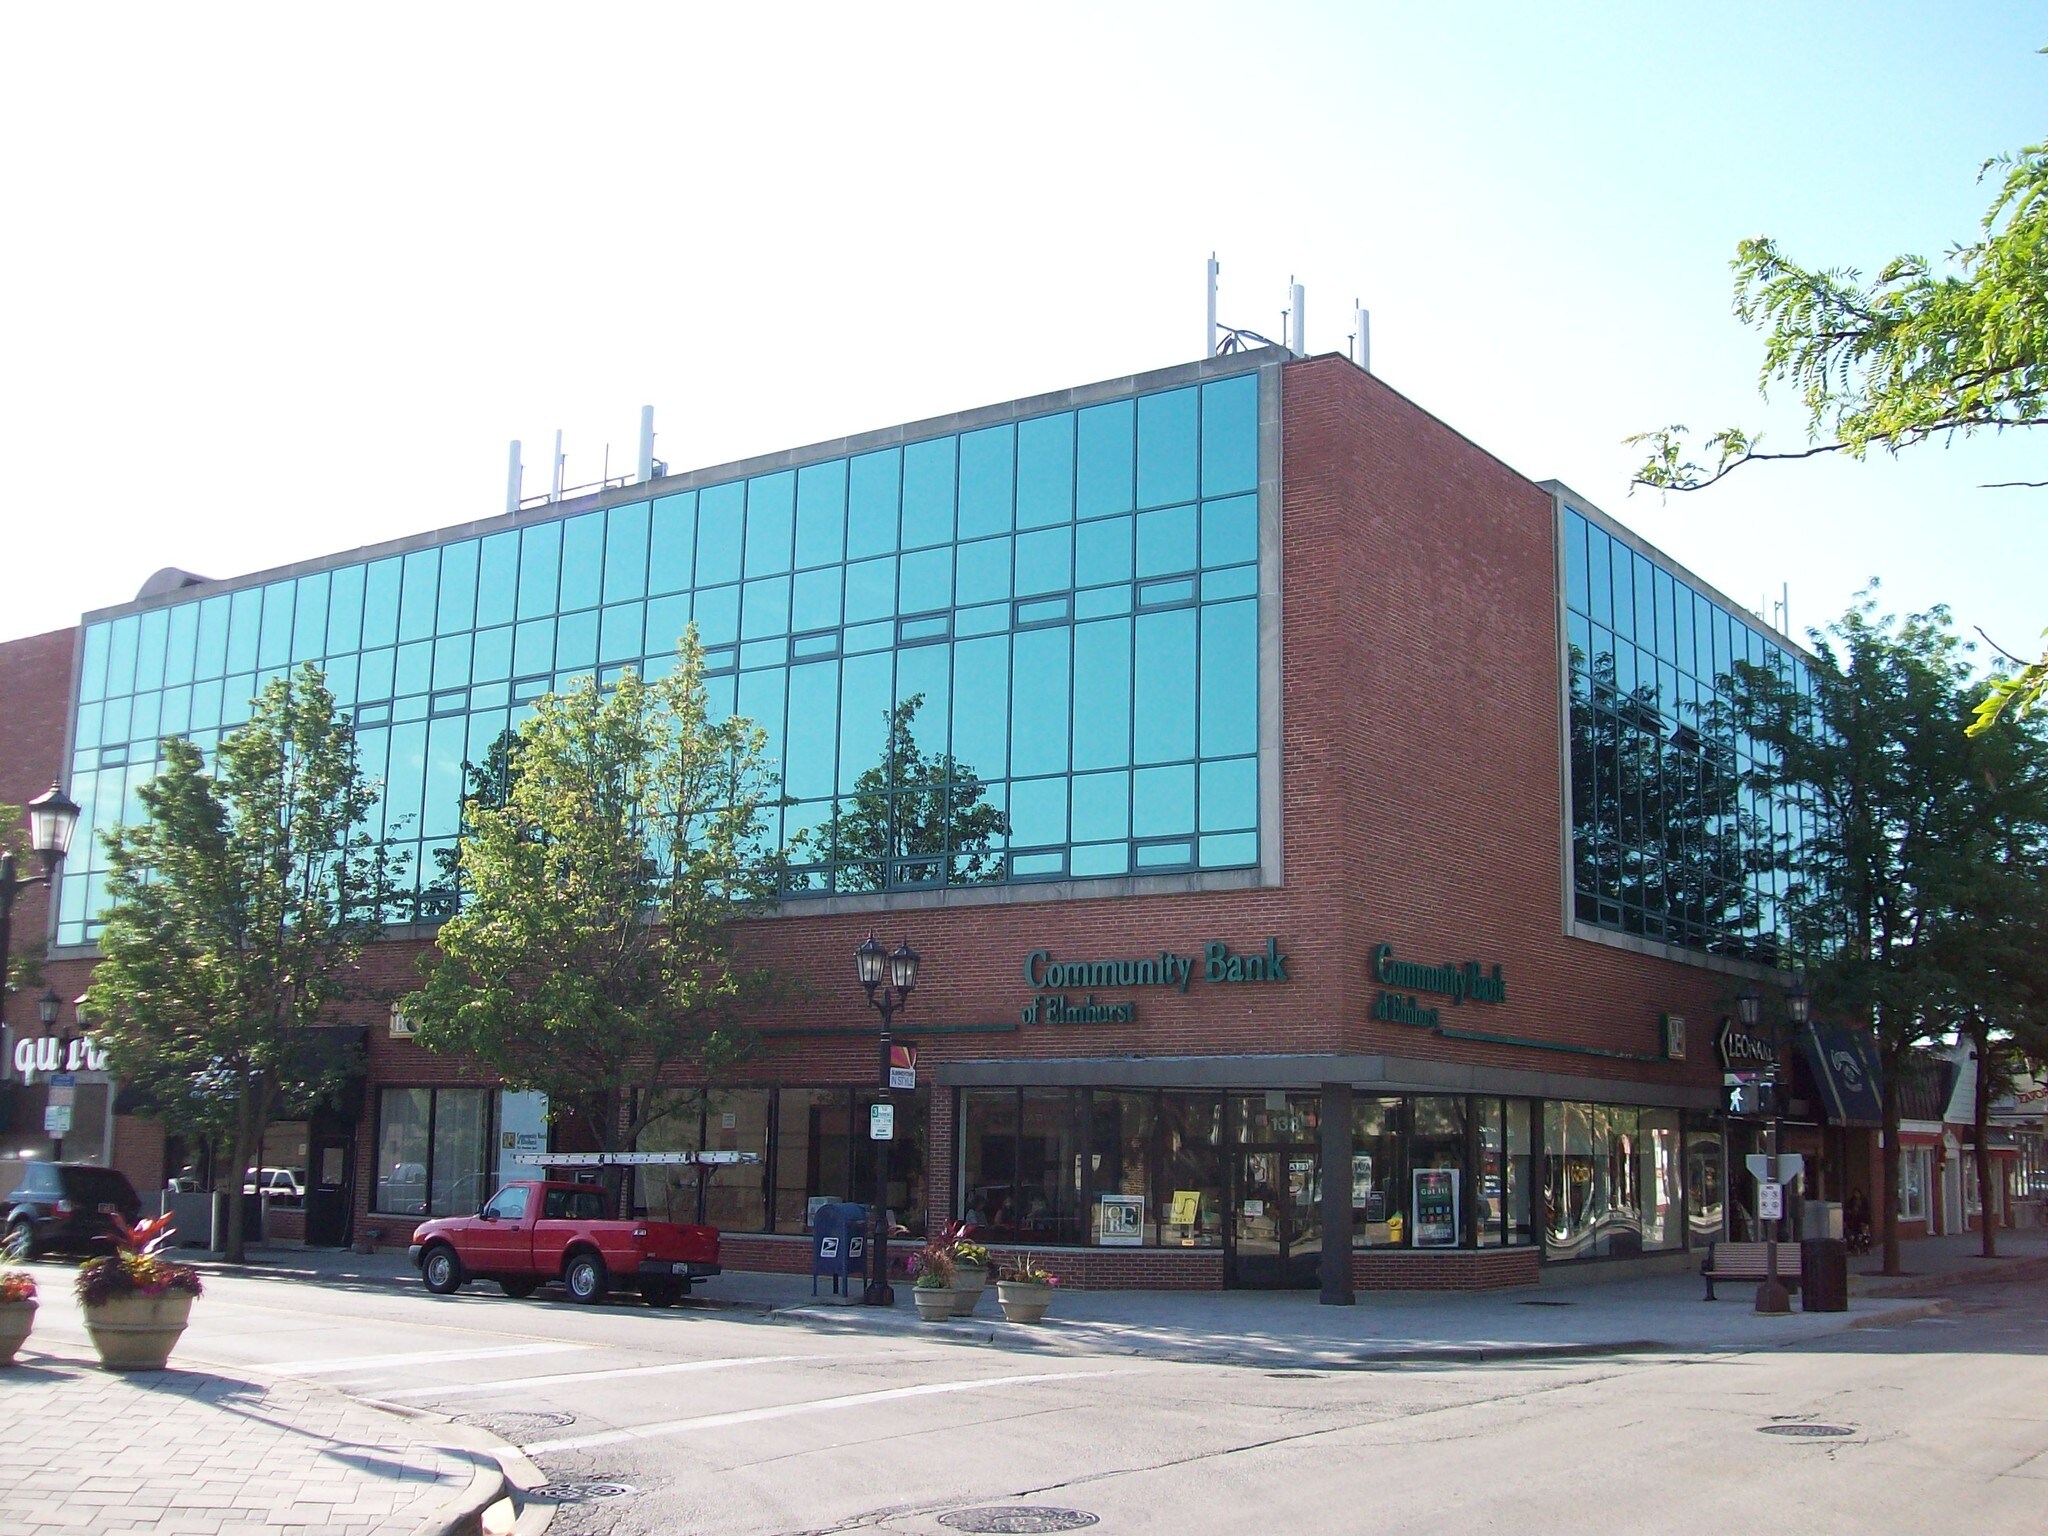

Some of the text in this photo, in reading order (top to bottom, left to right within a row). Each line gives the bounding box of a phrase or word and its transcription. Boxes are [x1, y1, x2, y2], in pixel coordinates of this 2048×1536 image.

[1024, 937, 1288, 995] Community Bank
[1373, 944, 1505, 1005] Community Bank
[1021, 994, 1134, 1024] of Elmhurst
